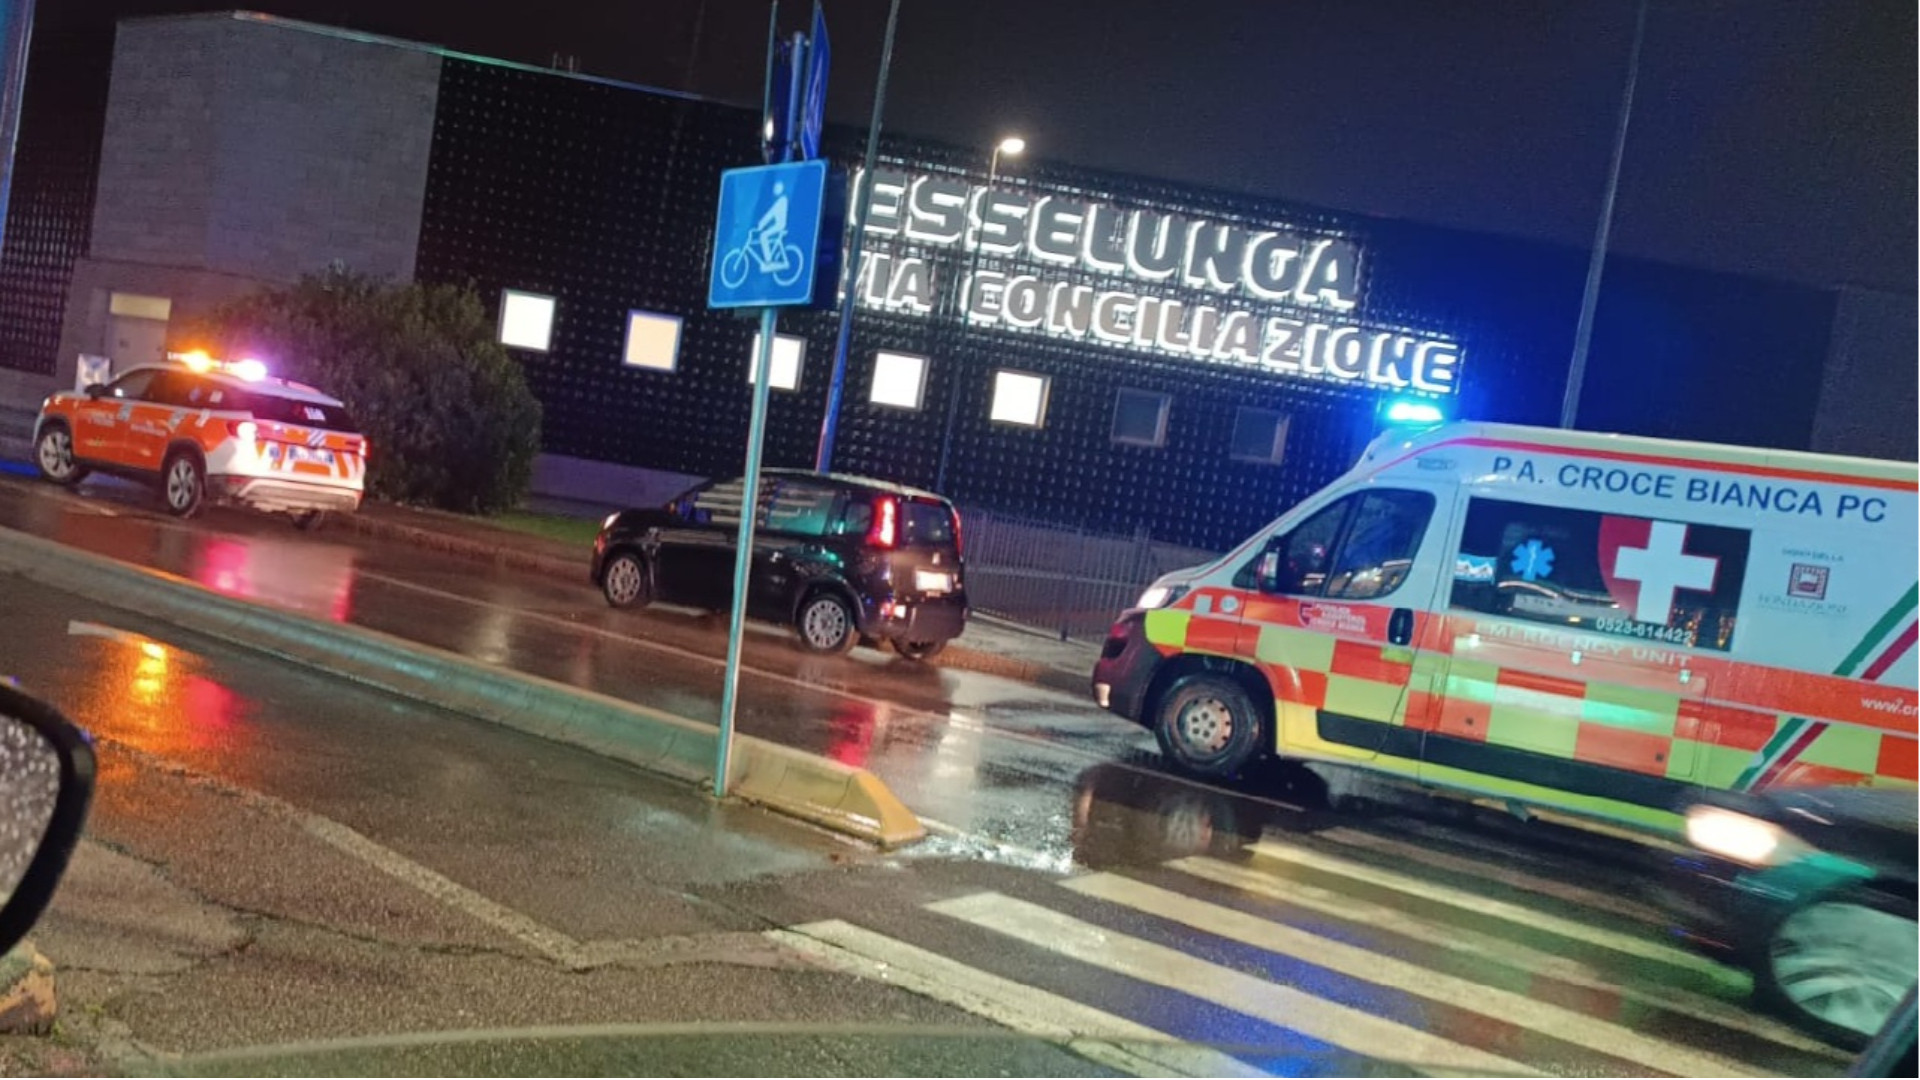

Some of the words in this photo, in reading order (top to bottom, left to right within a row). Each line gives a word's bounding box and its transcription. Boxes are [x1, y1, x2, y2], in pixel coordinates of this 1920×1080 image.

[850, 168, 1358, 309] ESSELUNGA
[844, 250, 932, 312] VIA
[960, 270, 1459, 393] CONCILIAZIONE
[1558, 463, 1676, 499] CROCE
[1686, 478, 1823, 516] BIANCA
[1837, 494, 1887, 522] PC
[1475, 621, 1625, 656] EMERGENCY
[1632, 648, 1694, 667] UNIT
[1596, 617, 1693, 643] 0523-614422
